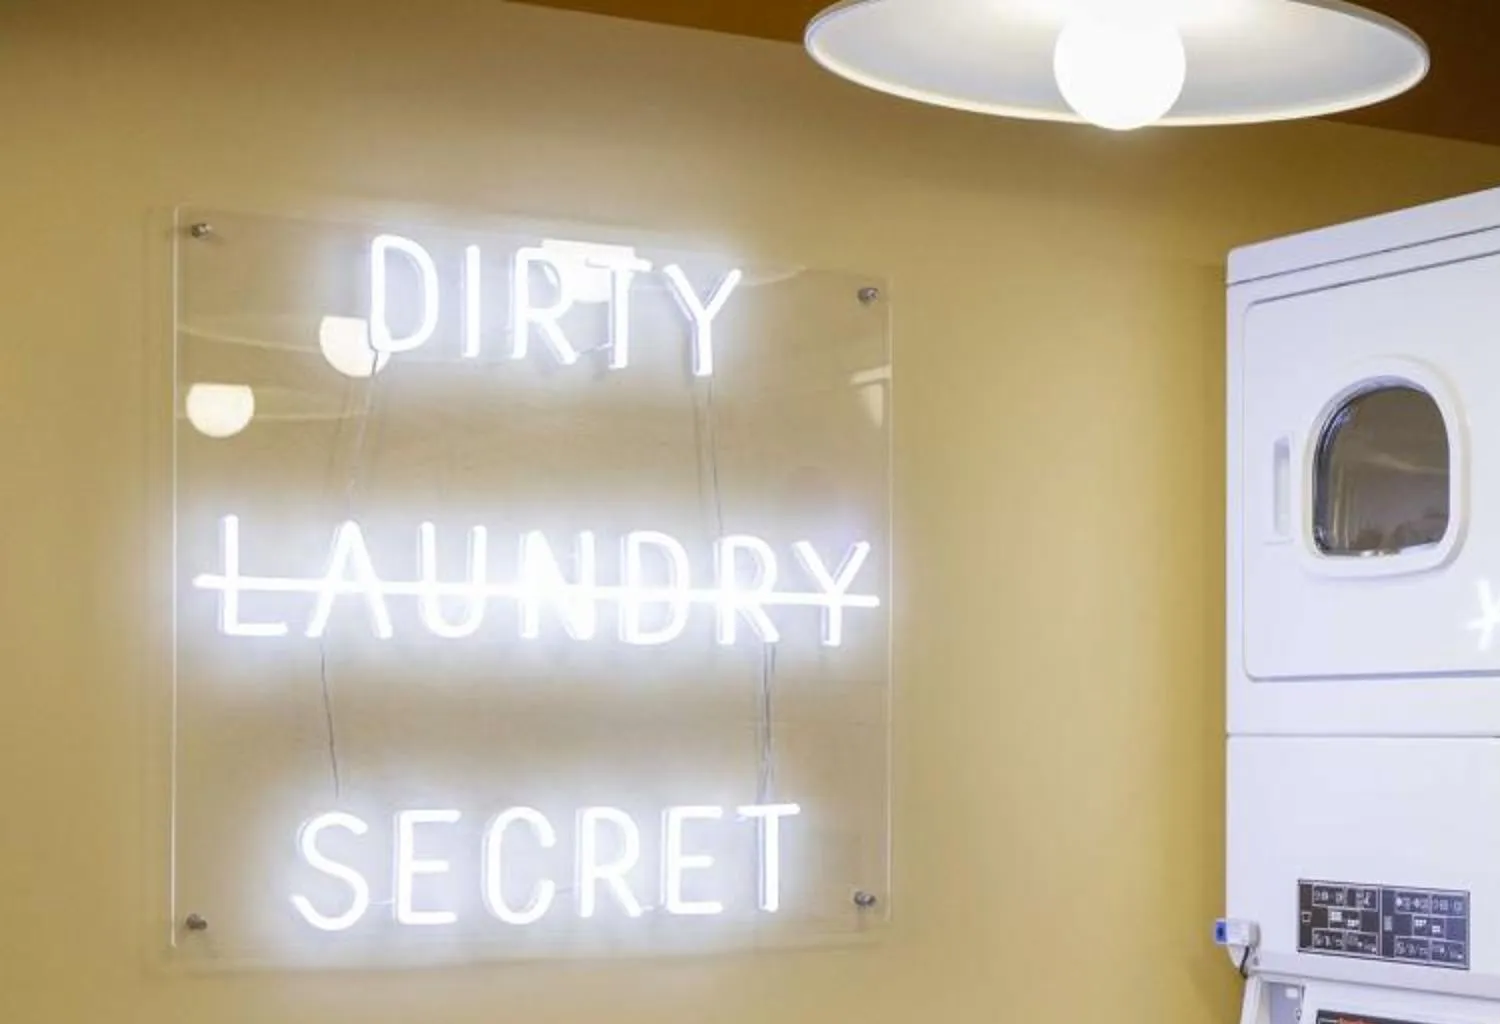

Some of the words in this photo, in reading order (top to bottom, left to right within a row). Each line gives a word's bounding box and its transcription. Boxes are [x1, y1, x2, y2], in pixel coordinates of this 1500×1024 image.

[367, 233, 743, 377] DIRTY
[212, 513, 874, 647] LAUNDRY
[289, 802, 802, 932] SECRET
